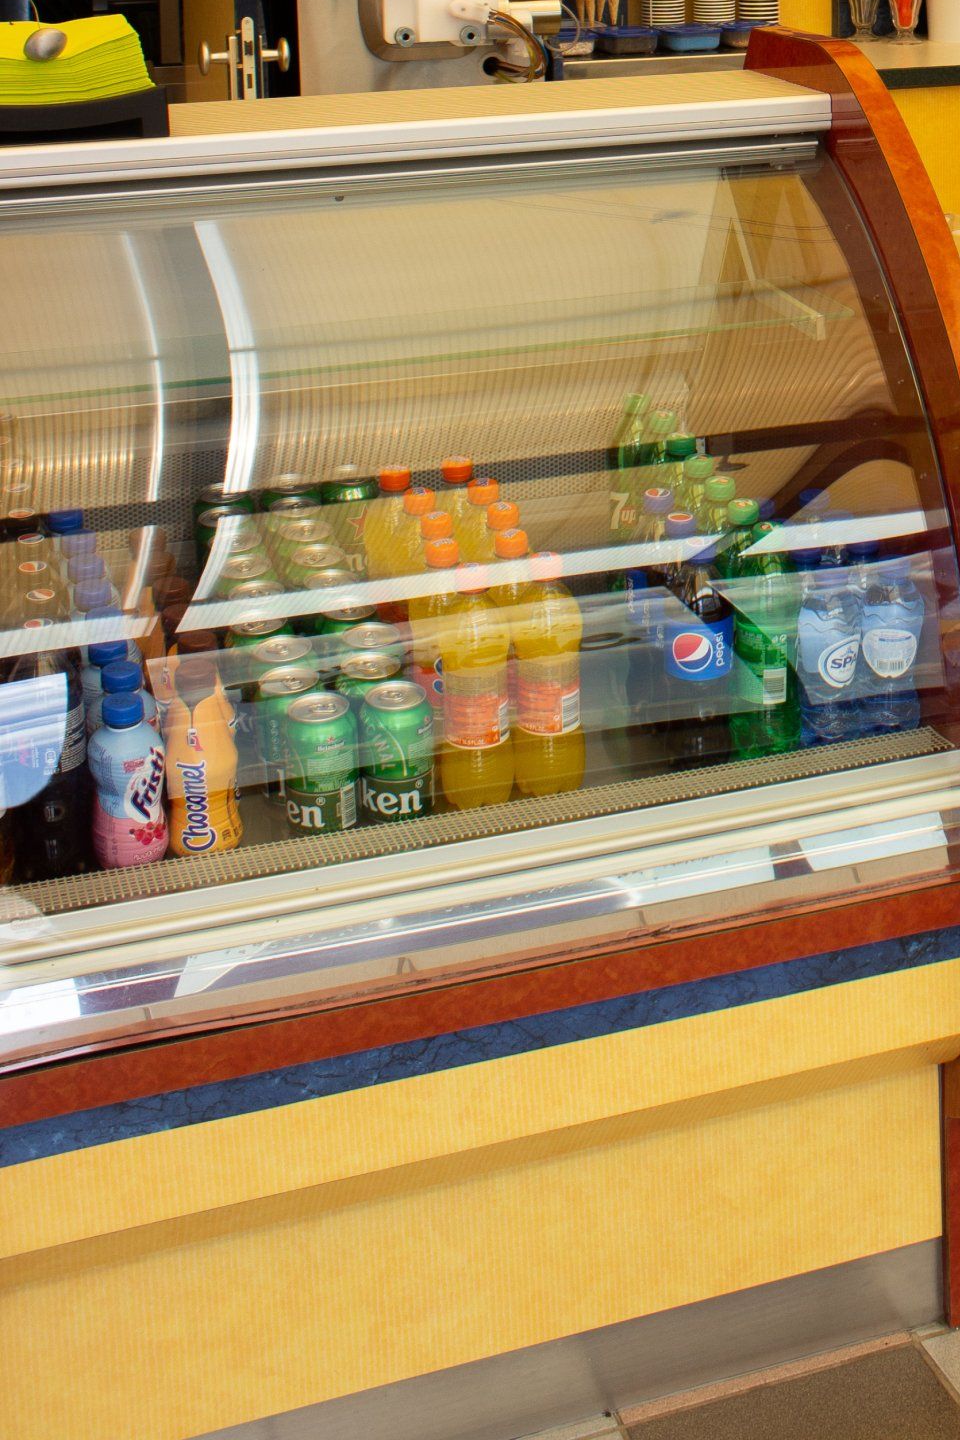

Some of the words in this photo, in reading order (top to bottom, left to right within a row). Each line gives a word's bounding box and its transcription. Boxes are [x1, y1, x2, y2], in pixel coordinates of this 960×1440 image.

[714, 630, 726, 667] pepsi
[130, 746, 165, 821] Fristi
[176, 760, 217, 852] Chocomel
